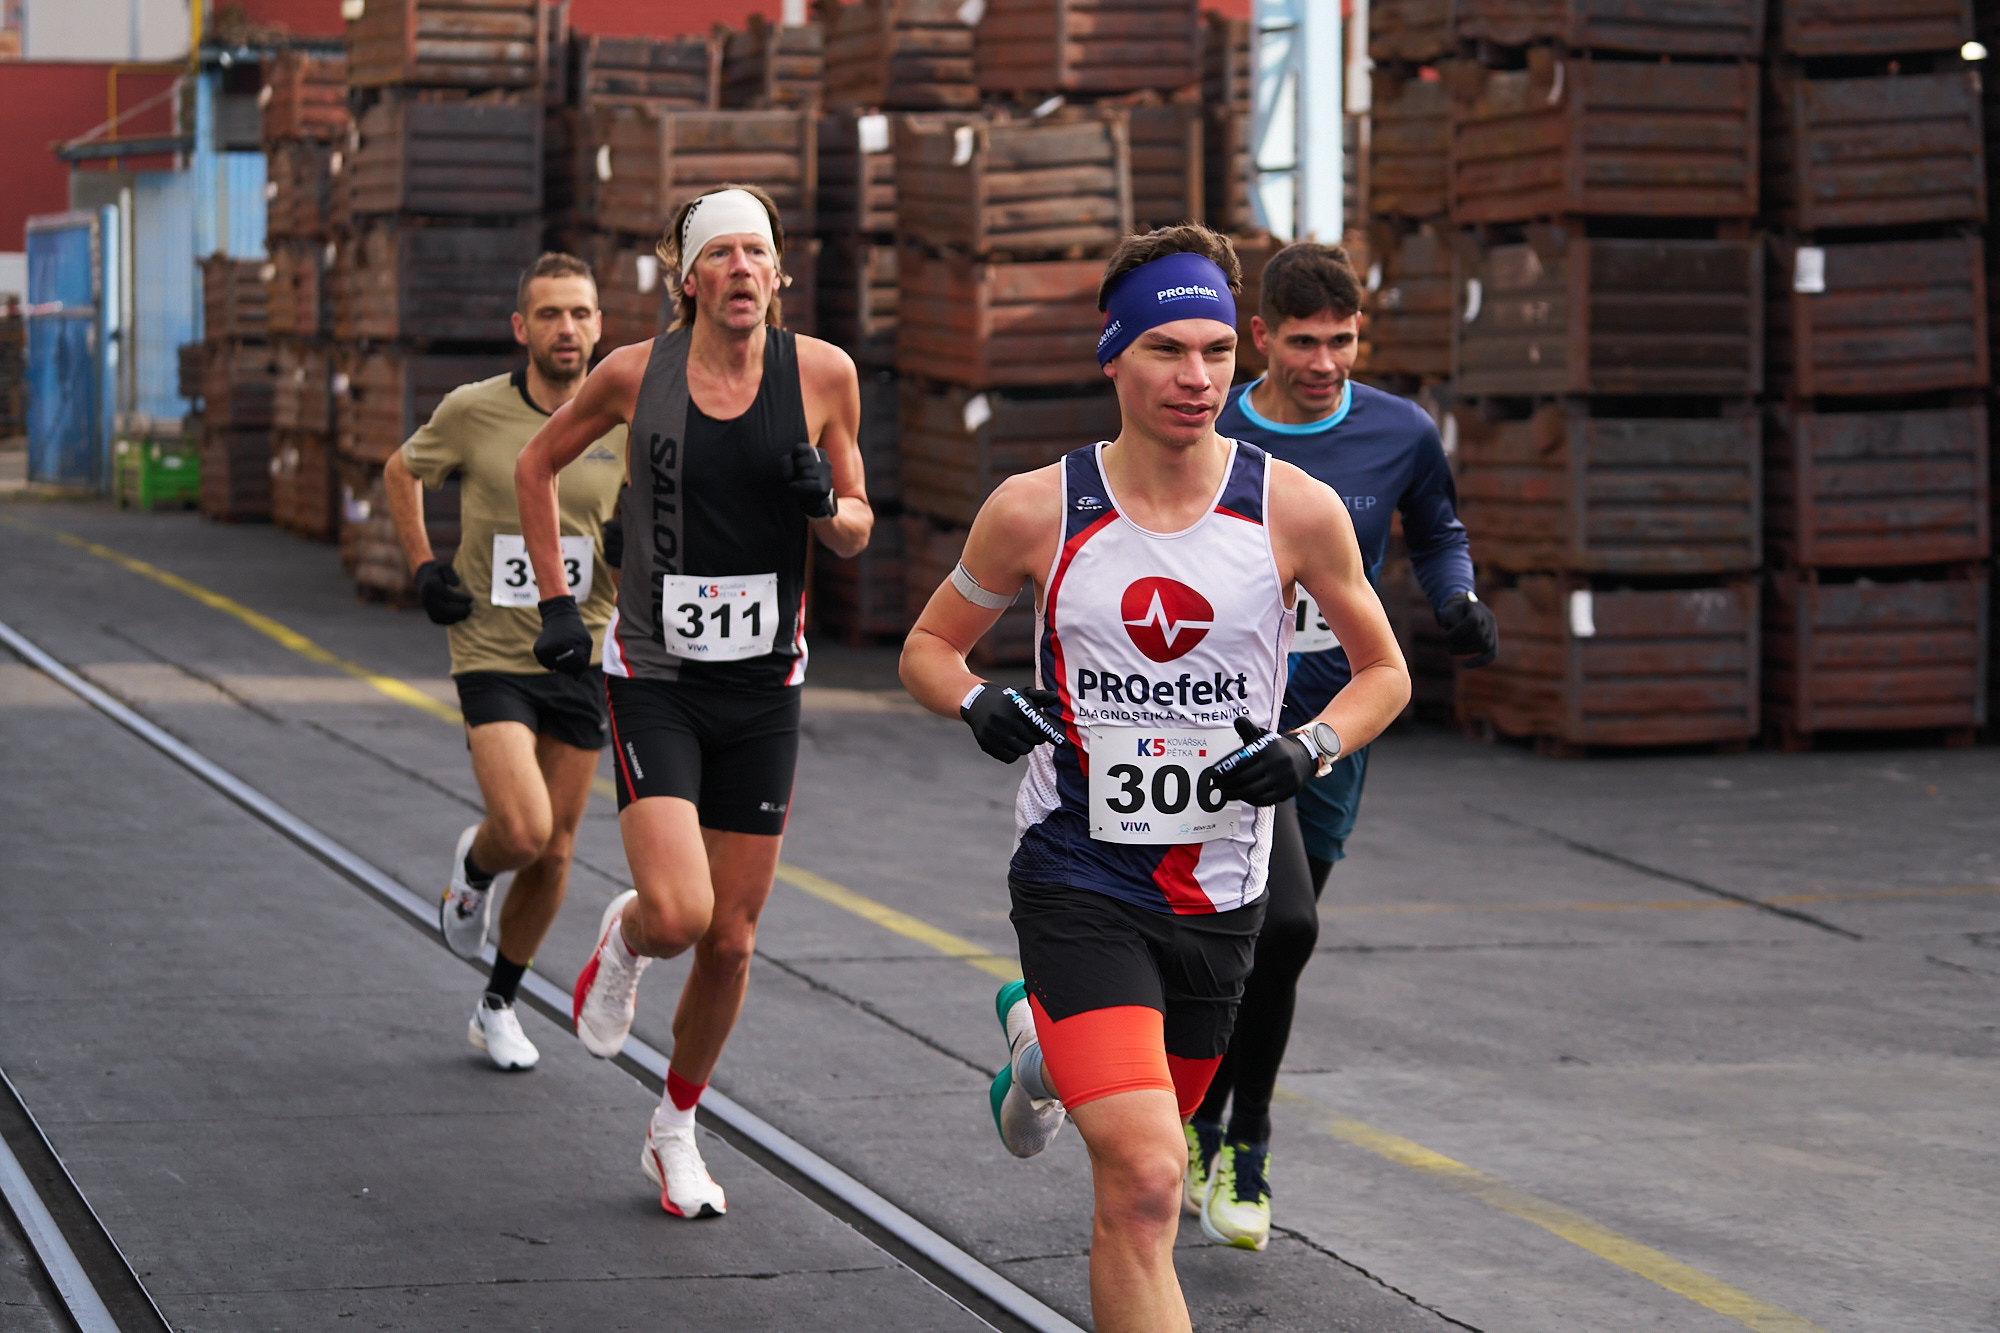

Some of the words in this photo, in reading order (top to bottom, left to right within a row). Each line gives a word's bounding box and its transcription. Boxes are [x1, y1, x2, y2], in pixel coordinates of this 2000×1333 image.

[1157, 285, 1218, 300] PROefekt
[505, 559, 581, 587] 33
[699, 585, 718, 598] K5
[676, 601, 761, 639] 311
[1078, 668, 1248, 706] PROefekt
[1079, 706, 1174, 722] DIAGNOSTIKA
[1192, 706, 1250, 723] TRÉNING
[1137, 738, 1166, 757] K5
[1166, 736, 1208, 747] KOVÁŘSKÁ
[1166, 747, 1193, 757] PĚTKA
[1105, 763, 1228, 815] 306
